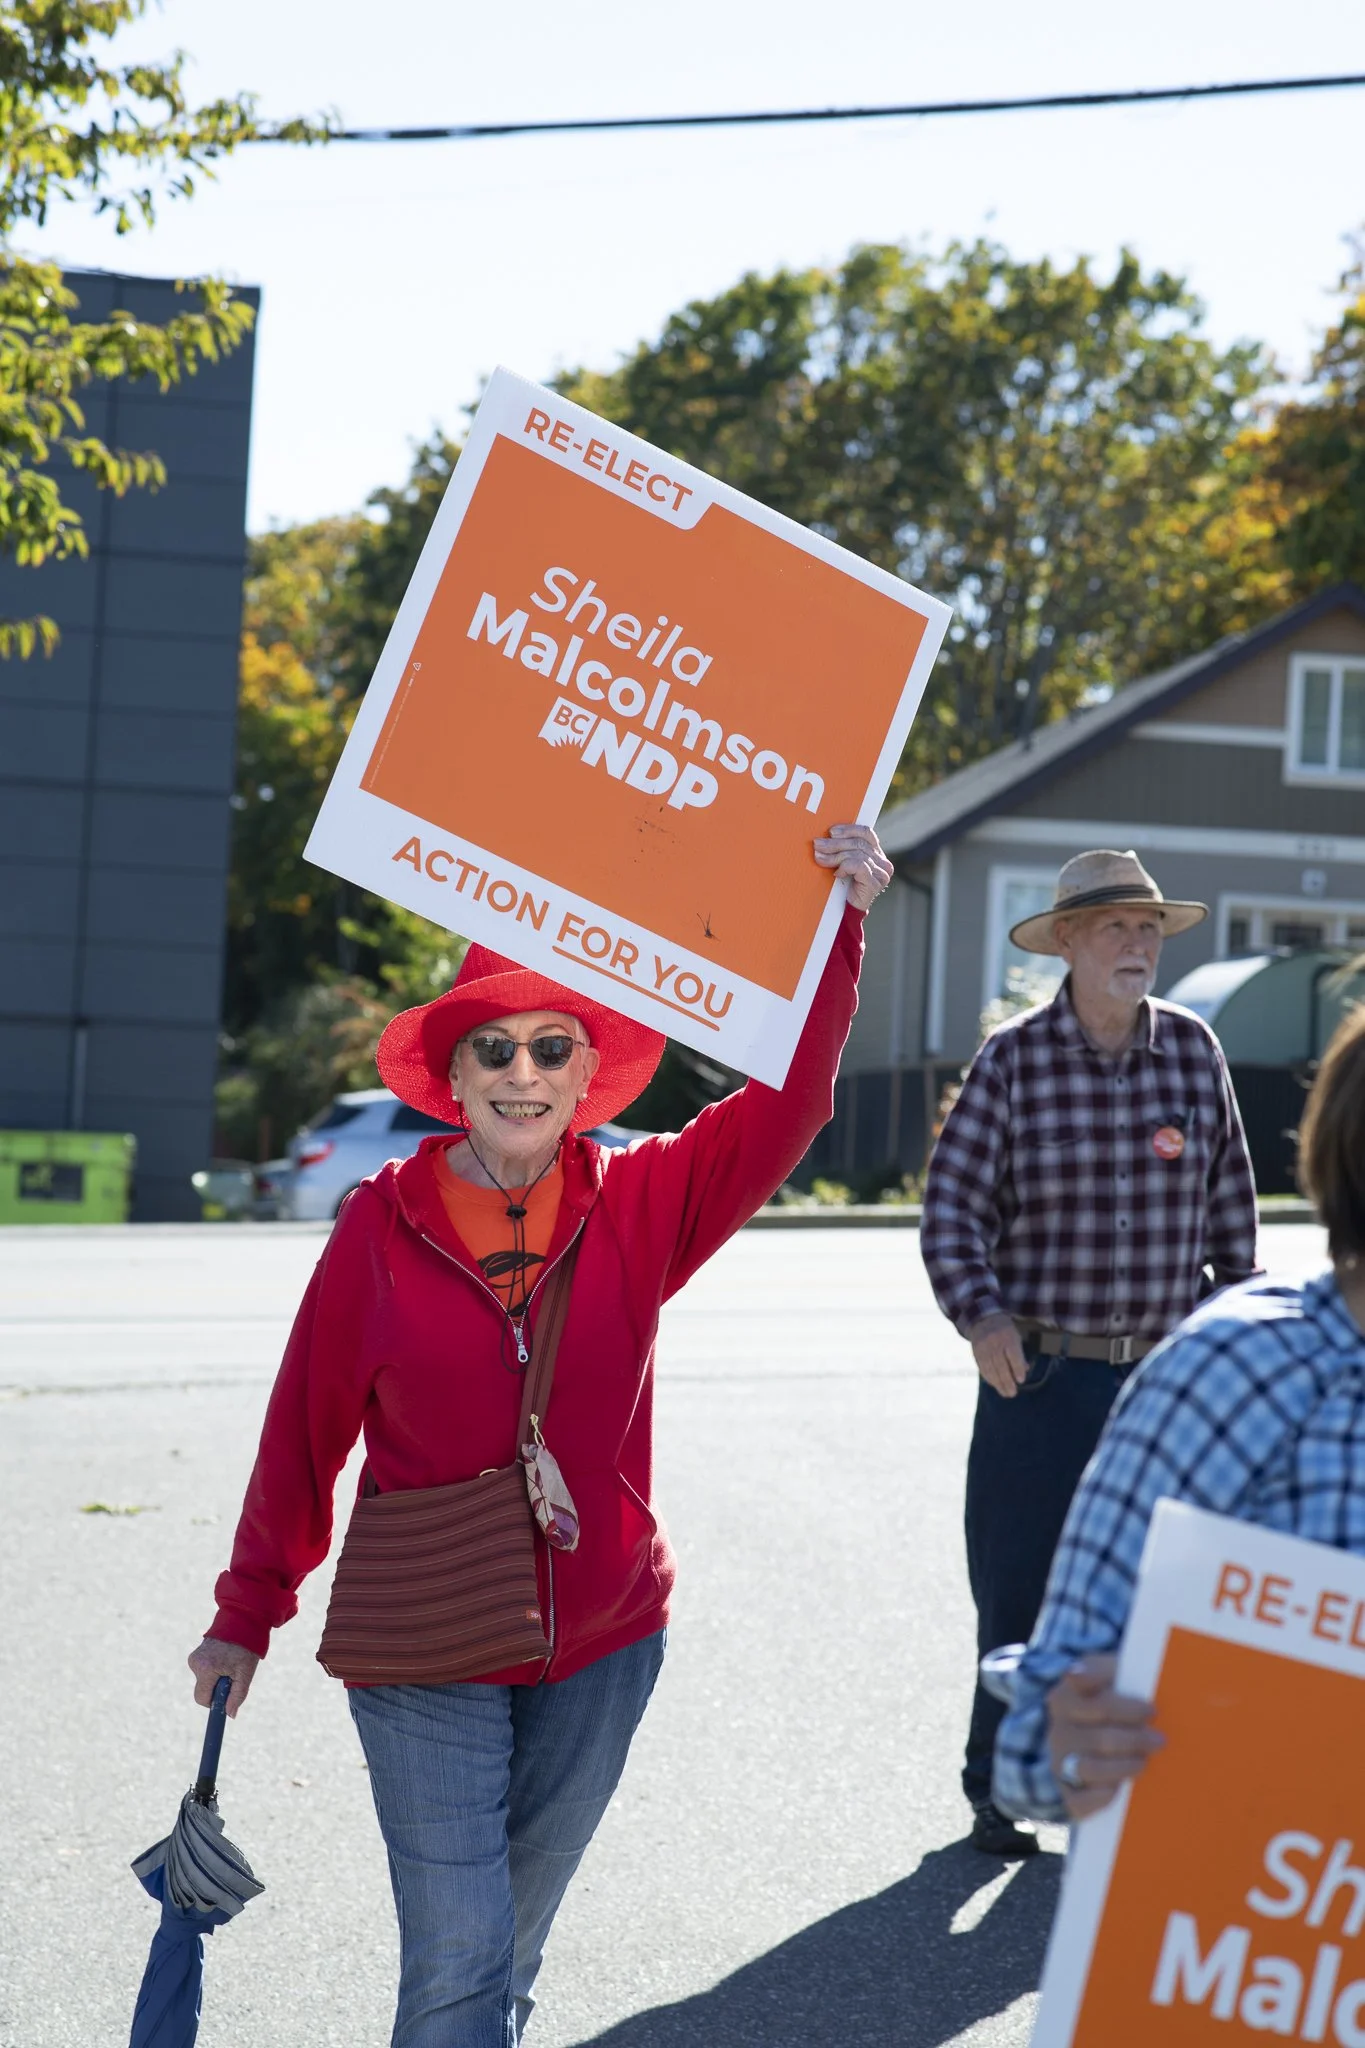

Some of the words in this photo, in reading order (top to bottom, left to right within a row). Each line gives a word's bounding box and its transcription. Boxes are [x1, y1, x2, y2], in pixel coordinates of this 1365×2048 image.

[523, 407, 694, 512] RE-ELECT
[529, 566, 714, 687] Sheila
[466, 591, 825, 815] Malcolmson
[552, 703, 591, 735] BC
[580, 717, 719, 811] NDP
[391, 836, 550, 932] ACTION
[556, 911, 639, 976] FOR
[653, 954, 734, 1019] YOU
[1246, 1829, 1365, 1938] Sh
